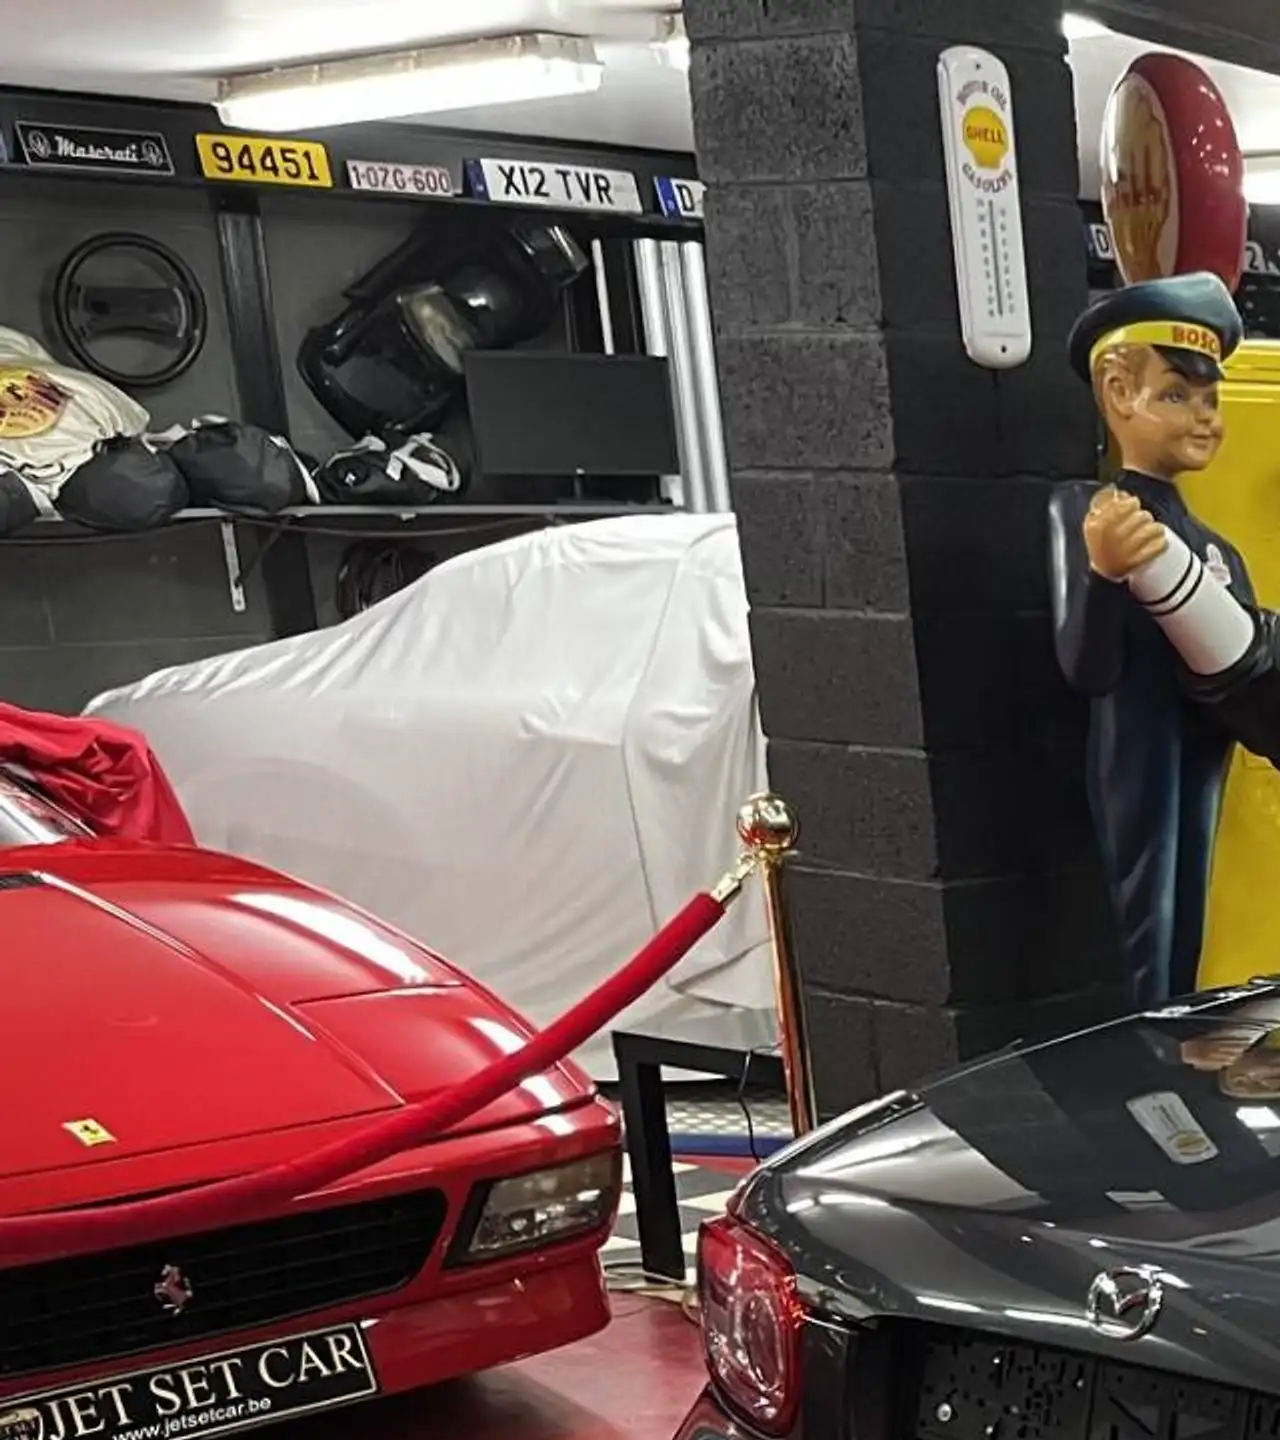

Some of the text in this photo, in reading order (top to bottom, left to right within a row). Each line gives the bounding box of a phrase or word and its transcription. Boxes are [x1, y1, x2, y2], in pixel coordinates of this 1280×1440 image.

[55, 135, 139, 164] Maserati
[966, 125, 1004, 145] SHELL
[211, 142, 319, 181] 94451
[555, 170, 615, 205] TVR
[149, 1357, 244, 1417] SET
[258, 1333, 366, 1389] CAR
